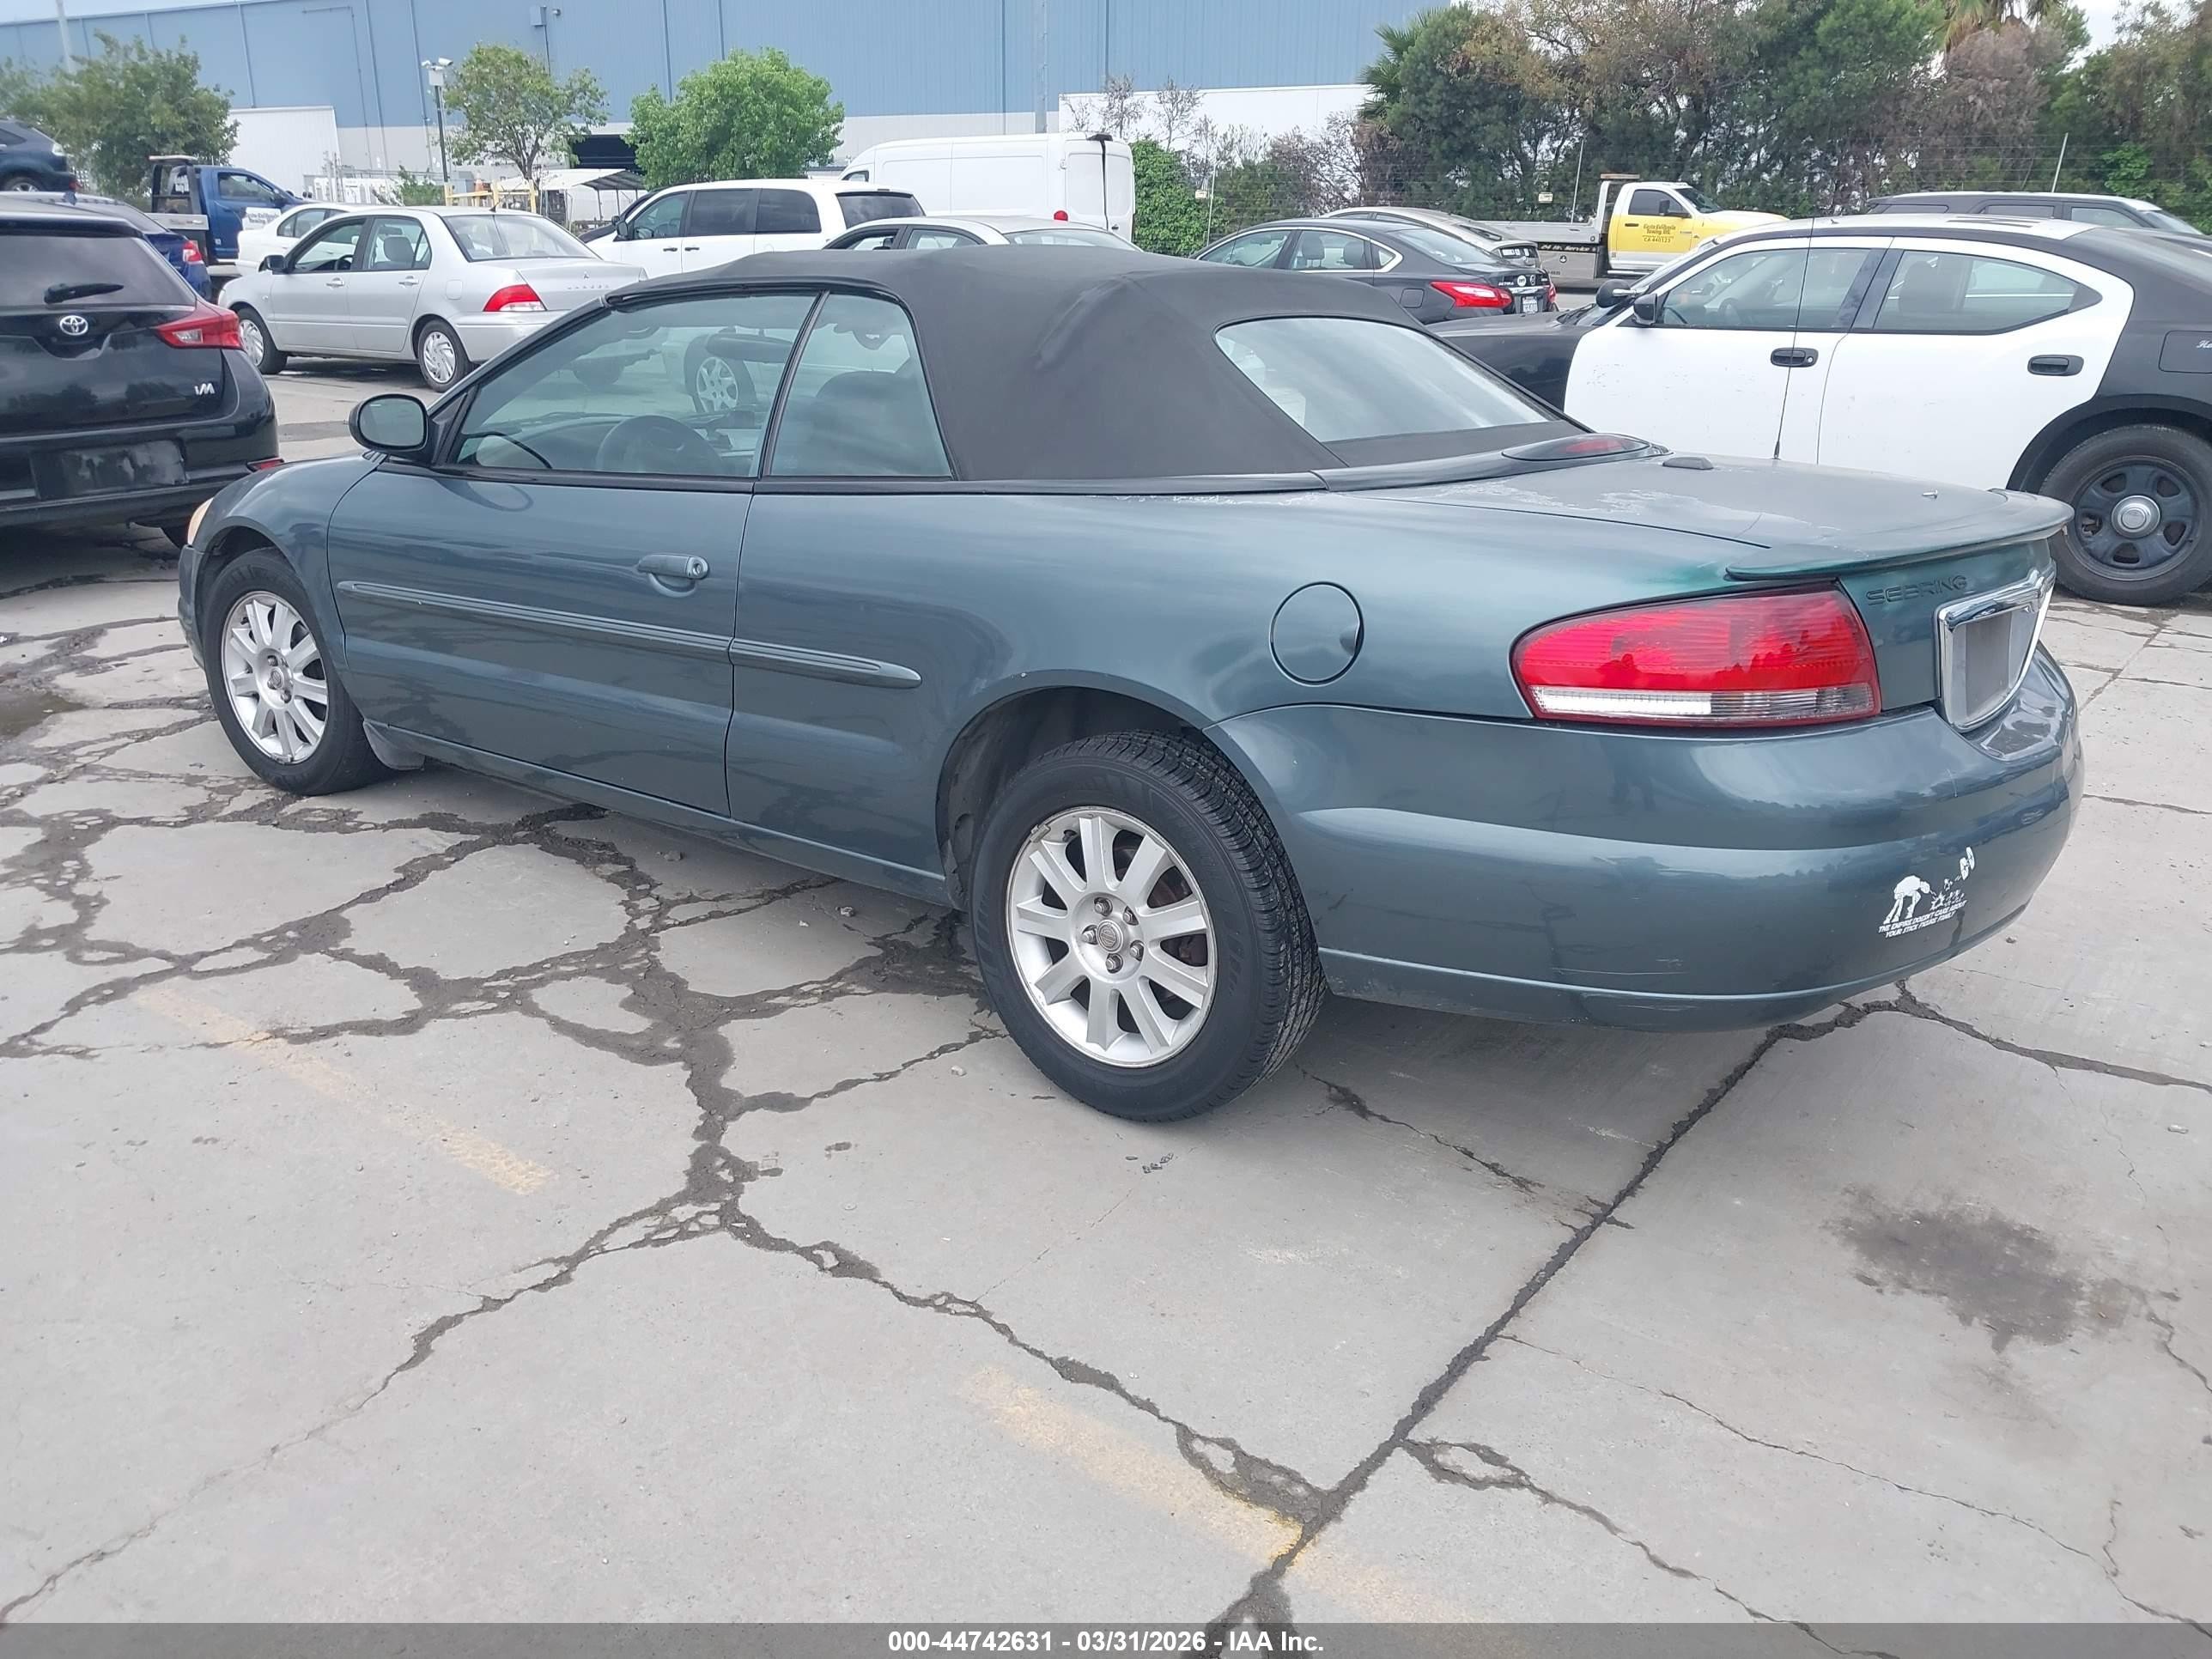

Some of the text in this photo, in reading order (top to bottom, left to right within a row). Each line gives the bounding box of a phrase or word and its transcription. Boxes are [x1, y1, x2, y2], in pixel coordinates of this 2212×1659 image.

[1866, 574, 1967, 605] SEBRING
[1878, 924, 1891, 933] THE
[1891, 919, 1913, 931] EMPIRE
[1934, 907, 1950, 917] CARE
[1949, 900, 1967, 911] ABOUT
[1885, 910, 1957, 938] YOUR STICK FIGURE FAMILY
